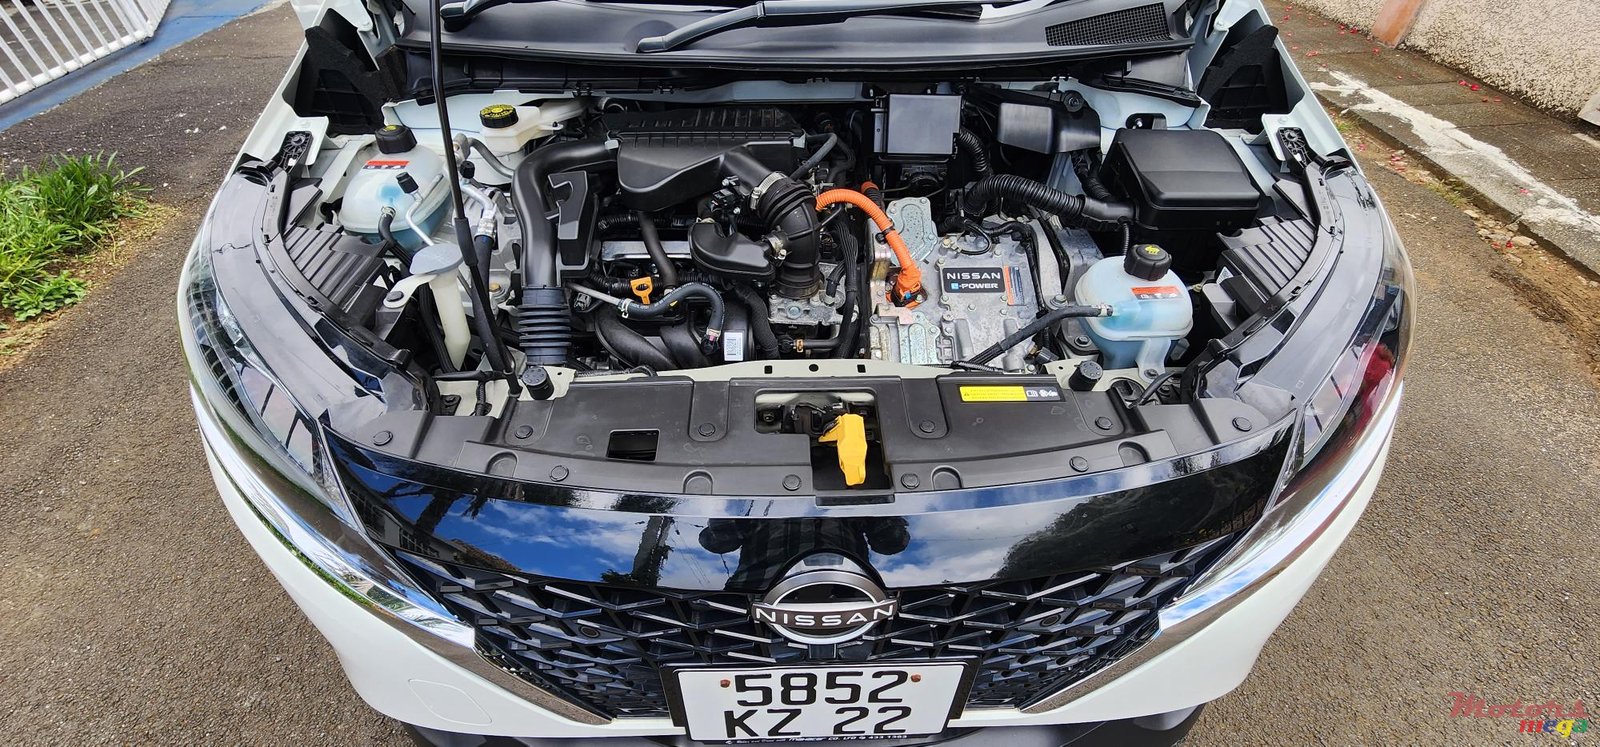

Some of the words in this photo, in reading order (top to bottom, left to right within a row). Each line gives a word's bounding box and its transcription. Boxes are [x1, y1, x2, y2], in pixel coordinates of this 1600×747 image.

[946, 272, 1001, 280] NISSAN
[755, 604, 894, 627] NISSAN
[734, 670, 909, 706] 5852
[723, 708, 802, 738] KZ
[833, 706, 912, 735] 22
